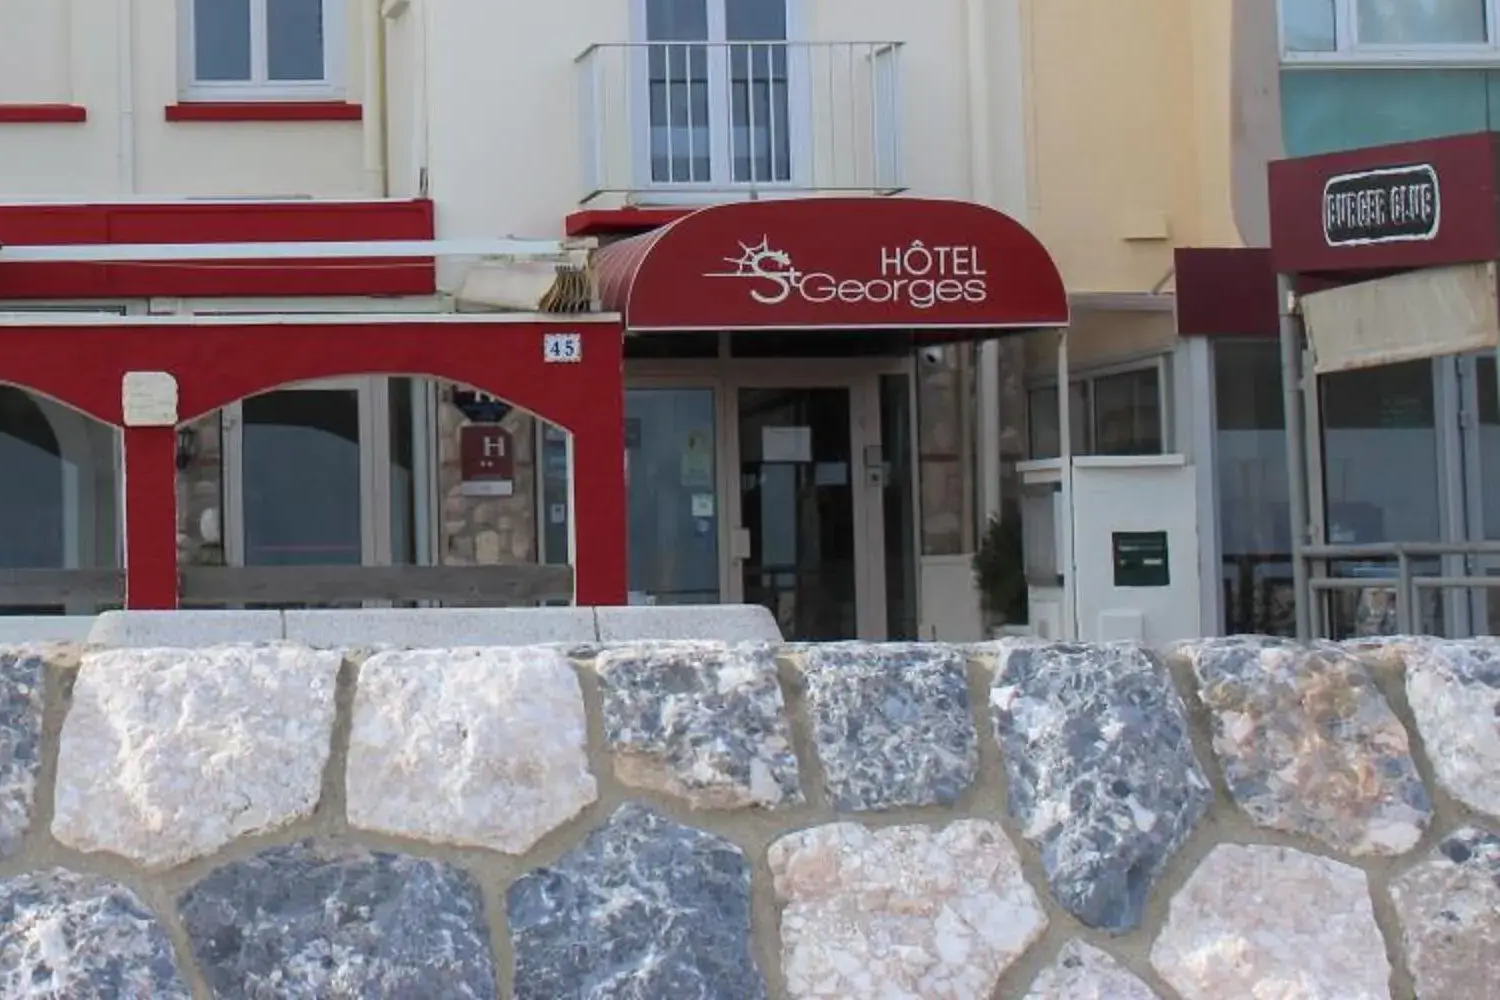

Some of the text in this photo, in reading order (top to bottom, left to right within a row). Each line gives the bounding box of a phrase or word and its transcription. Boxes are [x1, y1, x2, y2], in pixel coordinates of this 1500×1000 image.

[1327, 188, 1387, 229] BURGER
[881, 239, 987, 275] HÔTEL
[800, 272, 987, 308] Georges
[549, 339, 575, 357] 45
[483, 436, 505, 457] H
